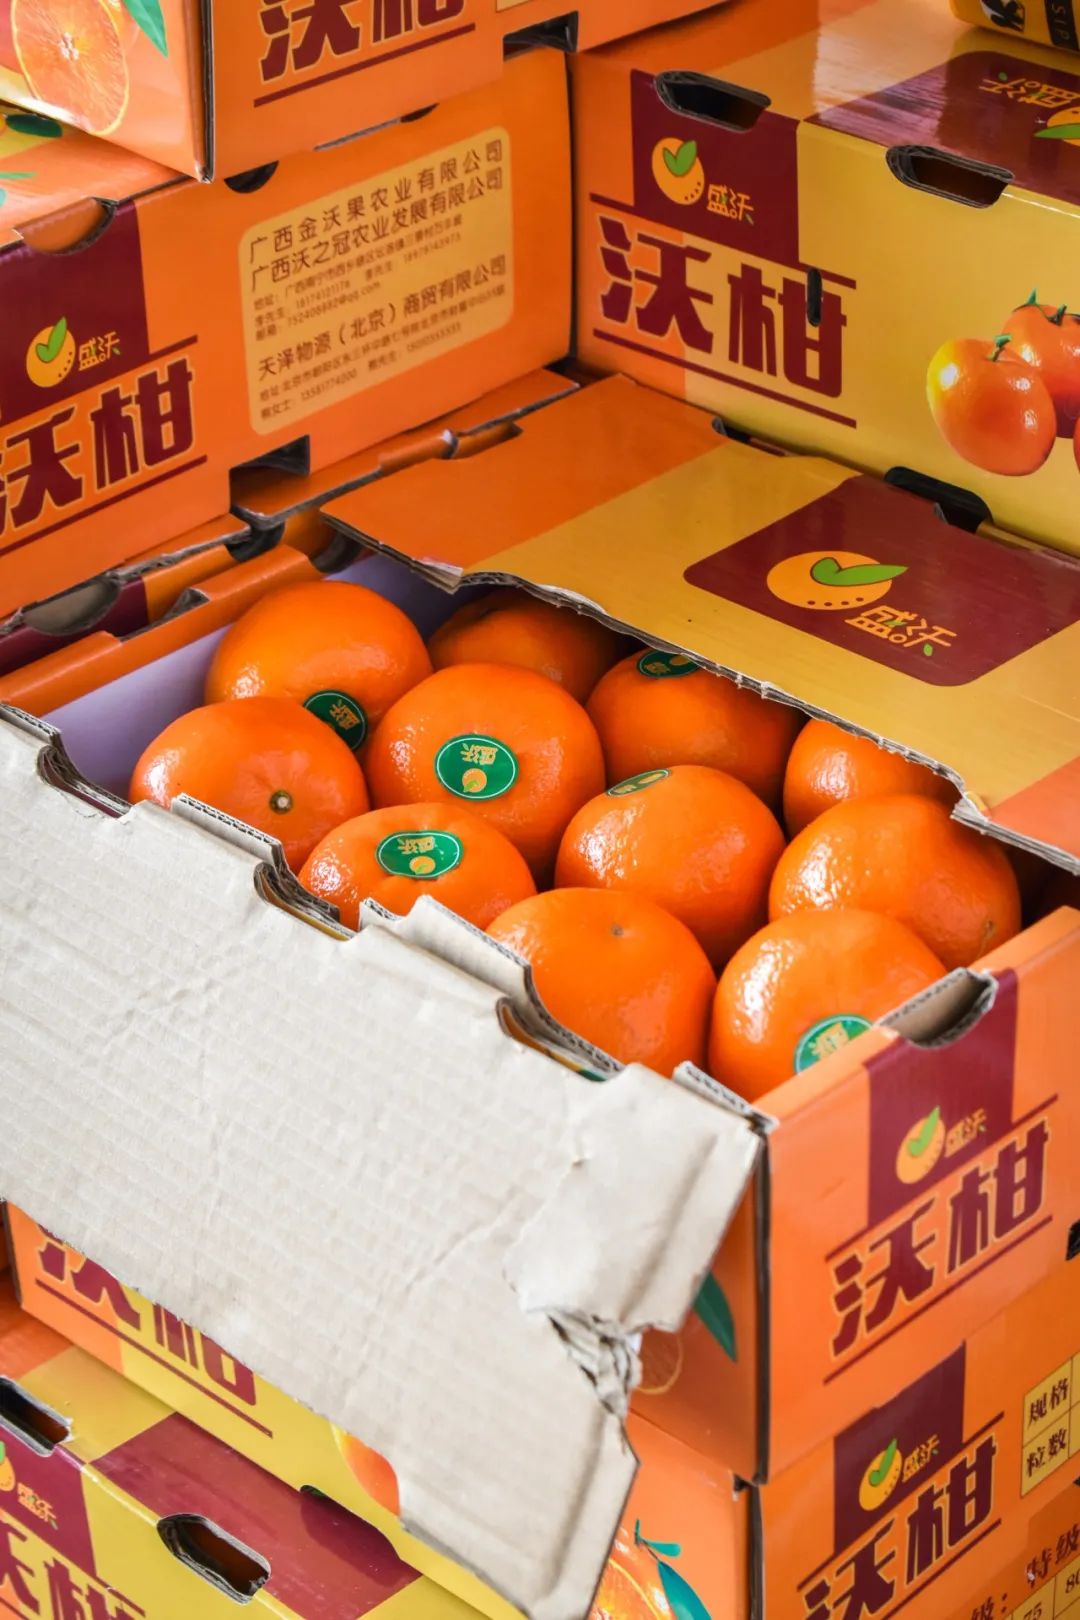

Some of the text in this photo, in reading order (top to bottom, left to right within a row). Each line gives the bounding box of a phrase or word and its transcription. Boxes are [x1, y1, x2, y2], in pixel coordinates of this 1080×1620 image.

[250, 139, 502, 265] 广西金沃果农业有限公司
[707, 184, 754, 224] 盛沃
[251, 167, 503, 293] 广西沃之冠农业发展有限公司
[598, 215, 847, 398] 沃柑
[79, 332, 120, 371] 盛沃
[845, 605, 957, 656] 盛沃
[945, 1109, 987, 1158] 盛沃
[832, 1119, 1050, 1357] 沃柑
[1028, 1378, 1069, 1427] 规格
[902, 1435, 940, 1483] 盛沃
[1026, 1428, 1068, 1478] 粒数
